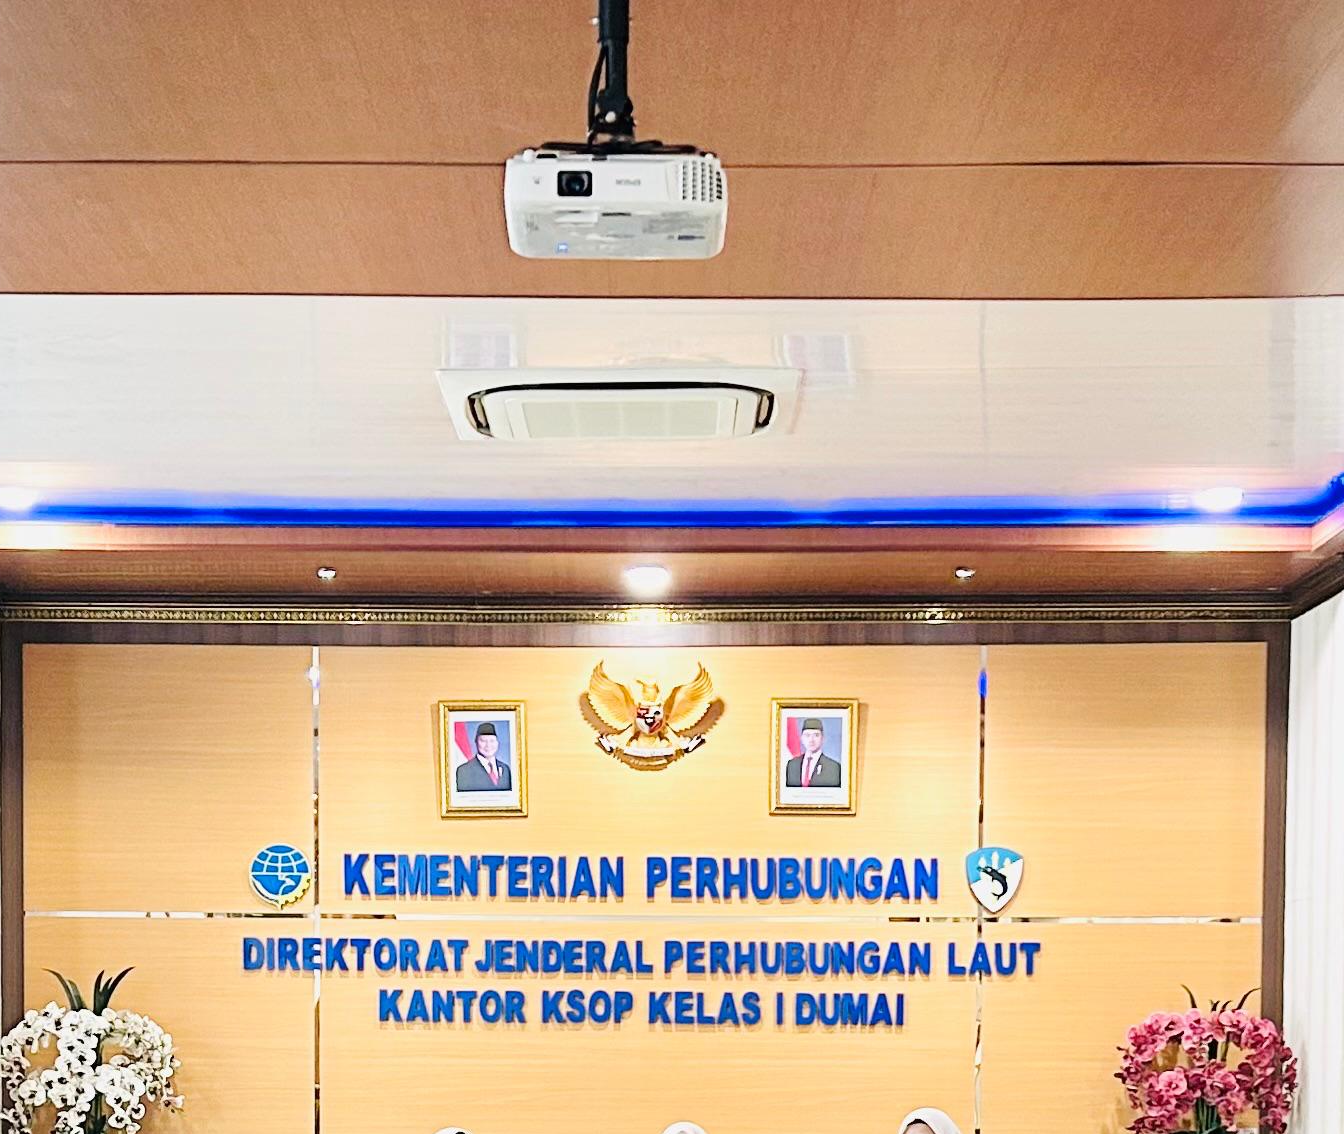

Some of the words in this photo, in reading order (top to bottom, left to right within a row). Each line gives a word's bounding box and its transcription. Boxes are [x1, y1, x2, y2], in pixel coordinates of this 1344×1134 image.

[343, 853, 625, 898] KEMENTERIAN
[646, 856, 939, 900] PERHUBUNGAN
[242, 937, 469, 972] DIREKTORAT
[475, 940, 654, 975] JENDERAL
[664, 941, 931, 976] PERHUBUNGAN
[947, 942, 1041, 976] LAUT
[378, 989, 527, 1024] KANTOR
[541, 990, 633, 1024] KSOP
[648, 991, 761, 1025] KELAS
[775, 993, 784, 1025] I
[795, 993, 905, 1026] DUMAI
